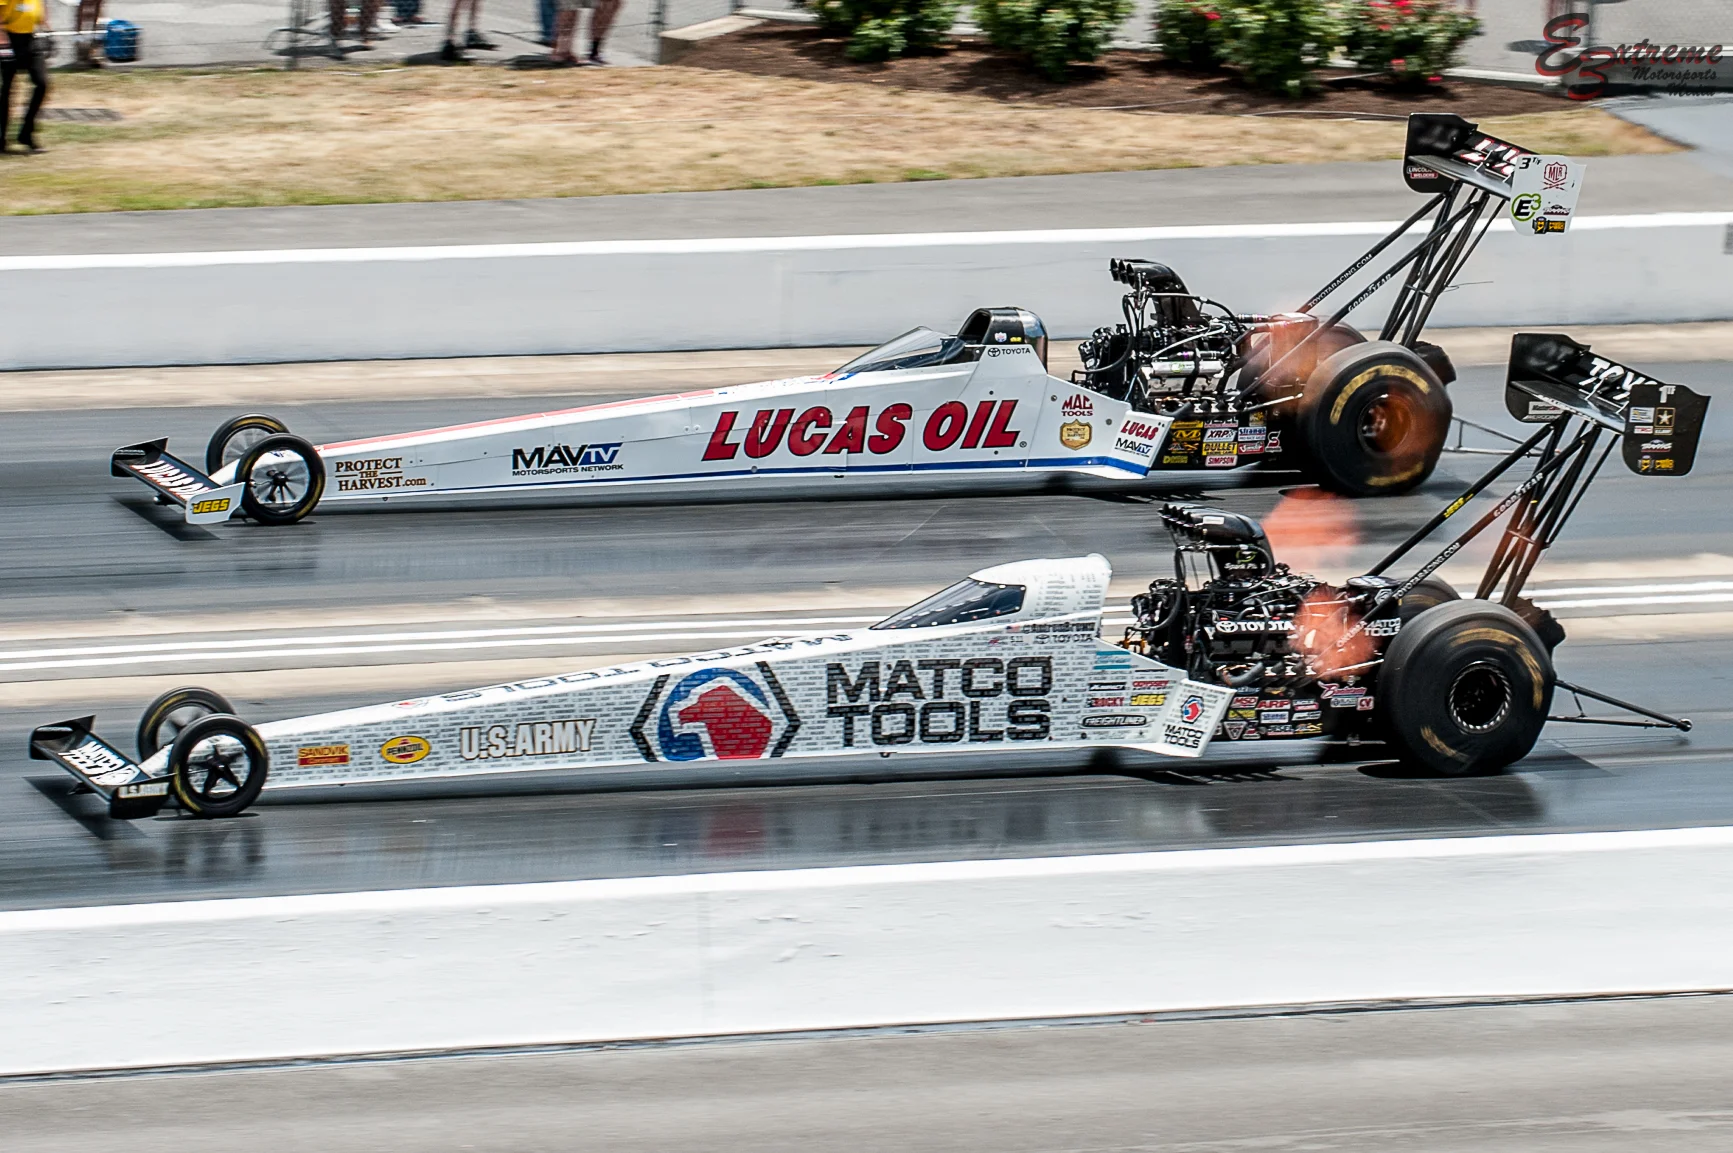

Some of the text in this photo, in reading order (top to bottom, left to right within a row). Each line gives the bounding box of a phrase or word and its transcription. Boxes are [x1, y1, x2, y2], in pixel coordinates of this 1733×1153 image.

[1548, 166, 1563, 181] MLR
[1002, 347, 1030, 355] TOYOTA
[1062, 394, 1093, 410] MAC
[701, 399, 1020, 461] LUCAS OIL
[1121, 419, 1159, 440] LUCAS
[1208, 430, 1229, 439] XRP
[1115, 437, 1153, 455] MAVTV
[1203, 442, 1237, 452] BULLET
[512, 442, 623, 470] MAVTV
[1208, 456, 1235, 465] SIMPSON
[335, 457, 402, 473] PROTECT
[512, 464, 624, 476] MOTORSPORTS NETWORK
[359, 470, 378, 478] THE
[338, 476, 426, 491] HARVEST.com
[192, 498, 230, 514] JEGS
[1224, 563, 1246, 571] Spark
[1364, 625, 1401, 637] TOOLS
[826, 656, 1052, 704] MATCO
[1129, 693, 1167, 706] JEGS
[1233, 697, 1257, 705] MSD
[1257, 700, 1290, 709] ARP
[826, 699, 1052, 748] TOOLS
[1084, 716, 1145, 726] FREIGHTLINER
[1165, 725, 1204, 740] MATCO
[1165, 734, 1200, 748] TOOLS
[298, 745, 349, 758] SANDVIK
[386, 742, 424, 756] PENNZOIL
